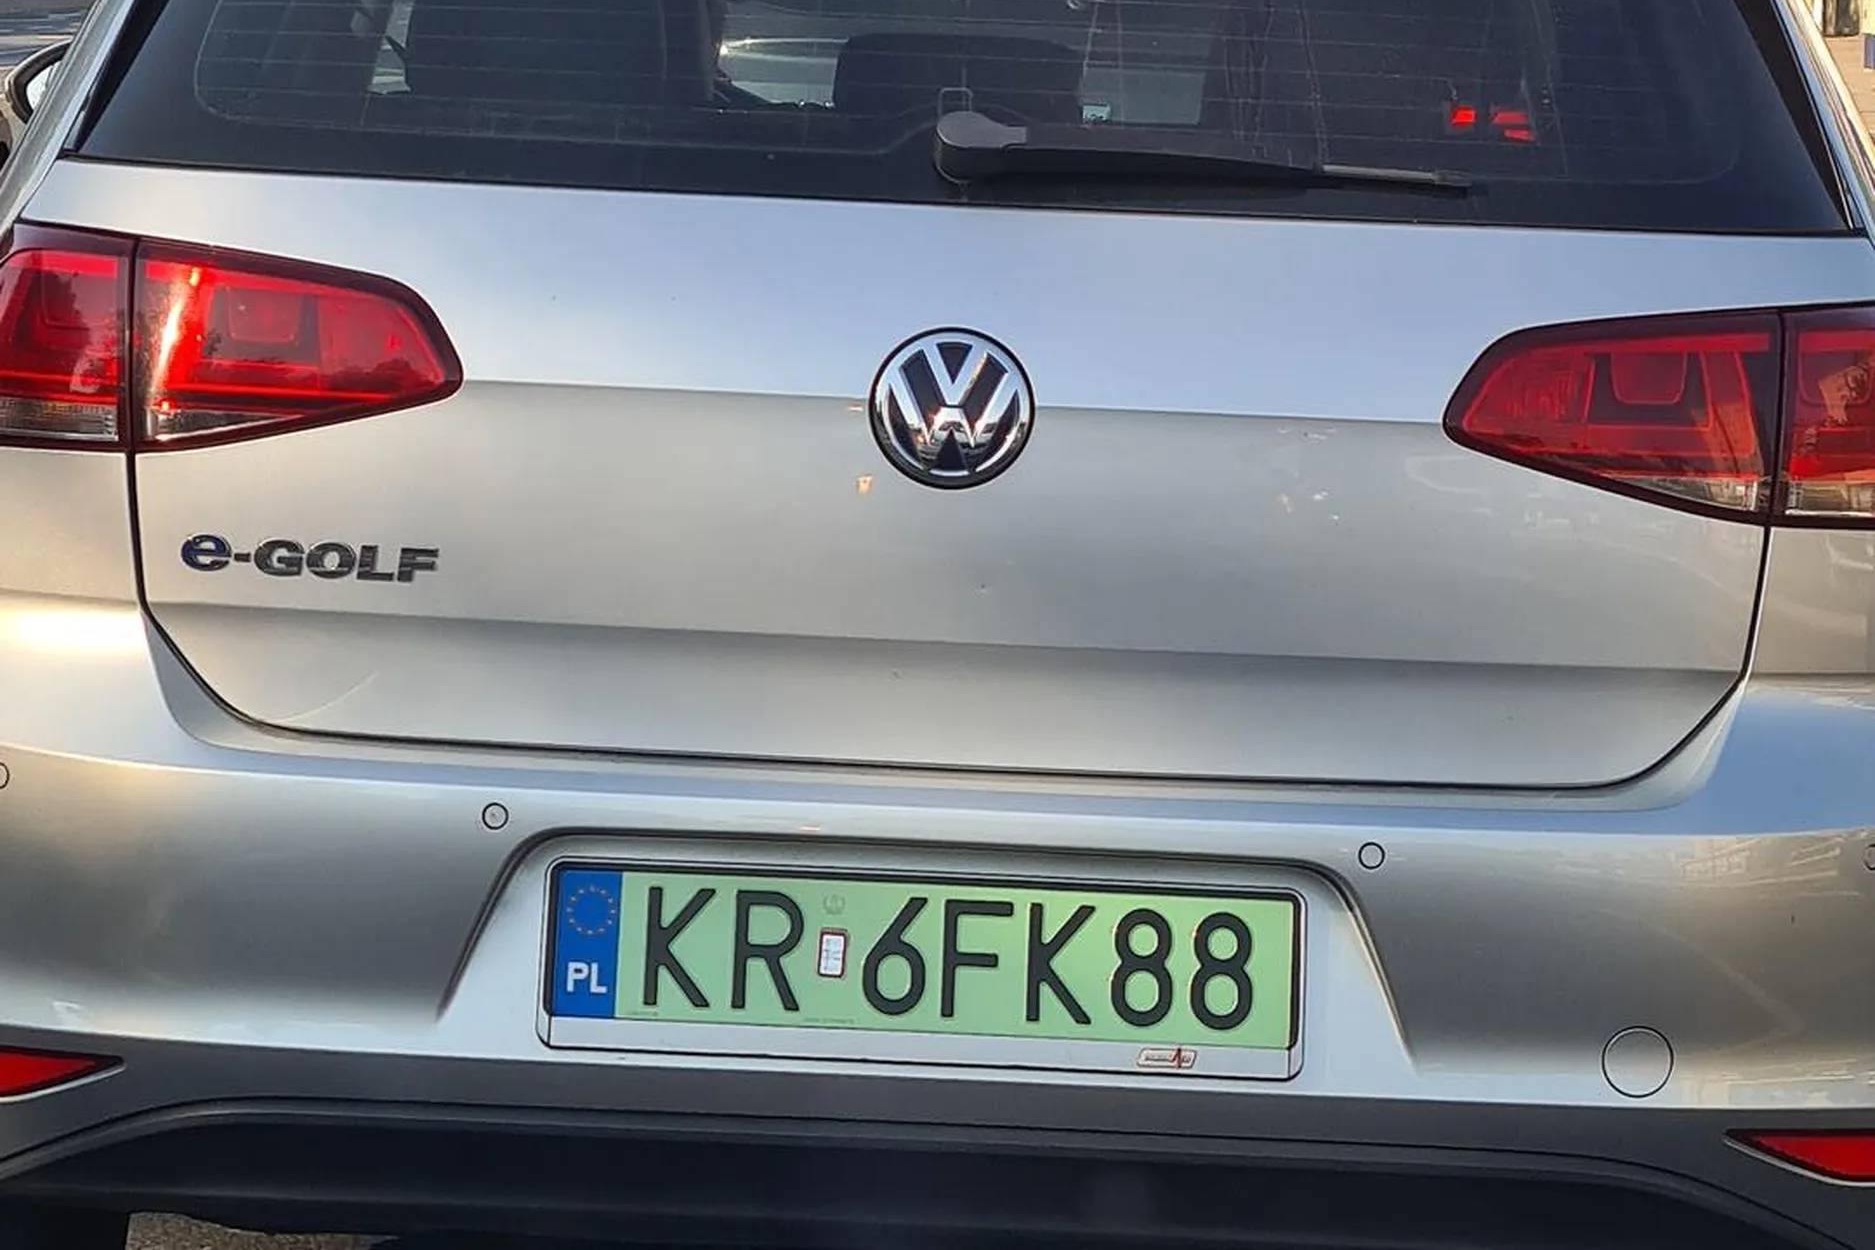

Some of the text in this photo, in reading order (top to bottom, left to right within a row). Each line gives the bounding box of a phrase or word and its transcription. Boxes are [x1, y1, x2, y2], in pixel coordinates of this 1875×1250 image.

[181, 533, 440, 583] e-GOLF
[566, 961, 608, 994] PL
[641, 884, 1255, 1031] KR 6FK88
